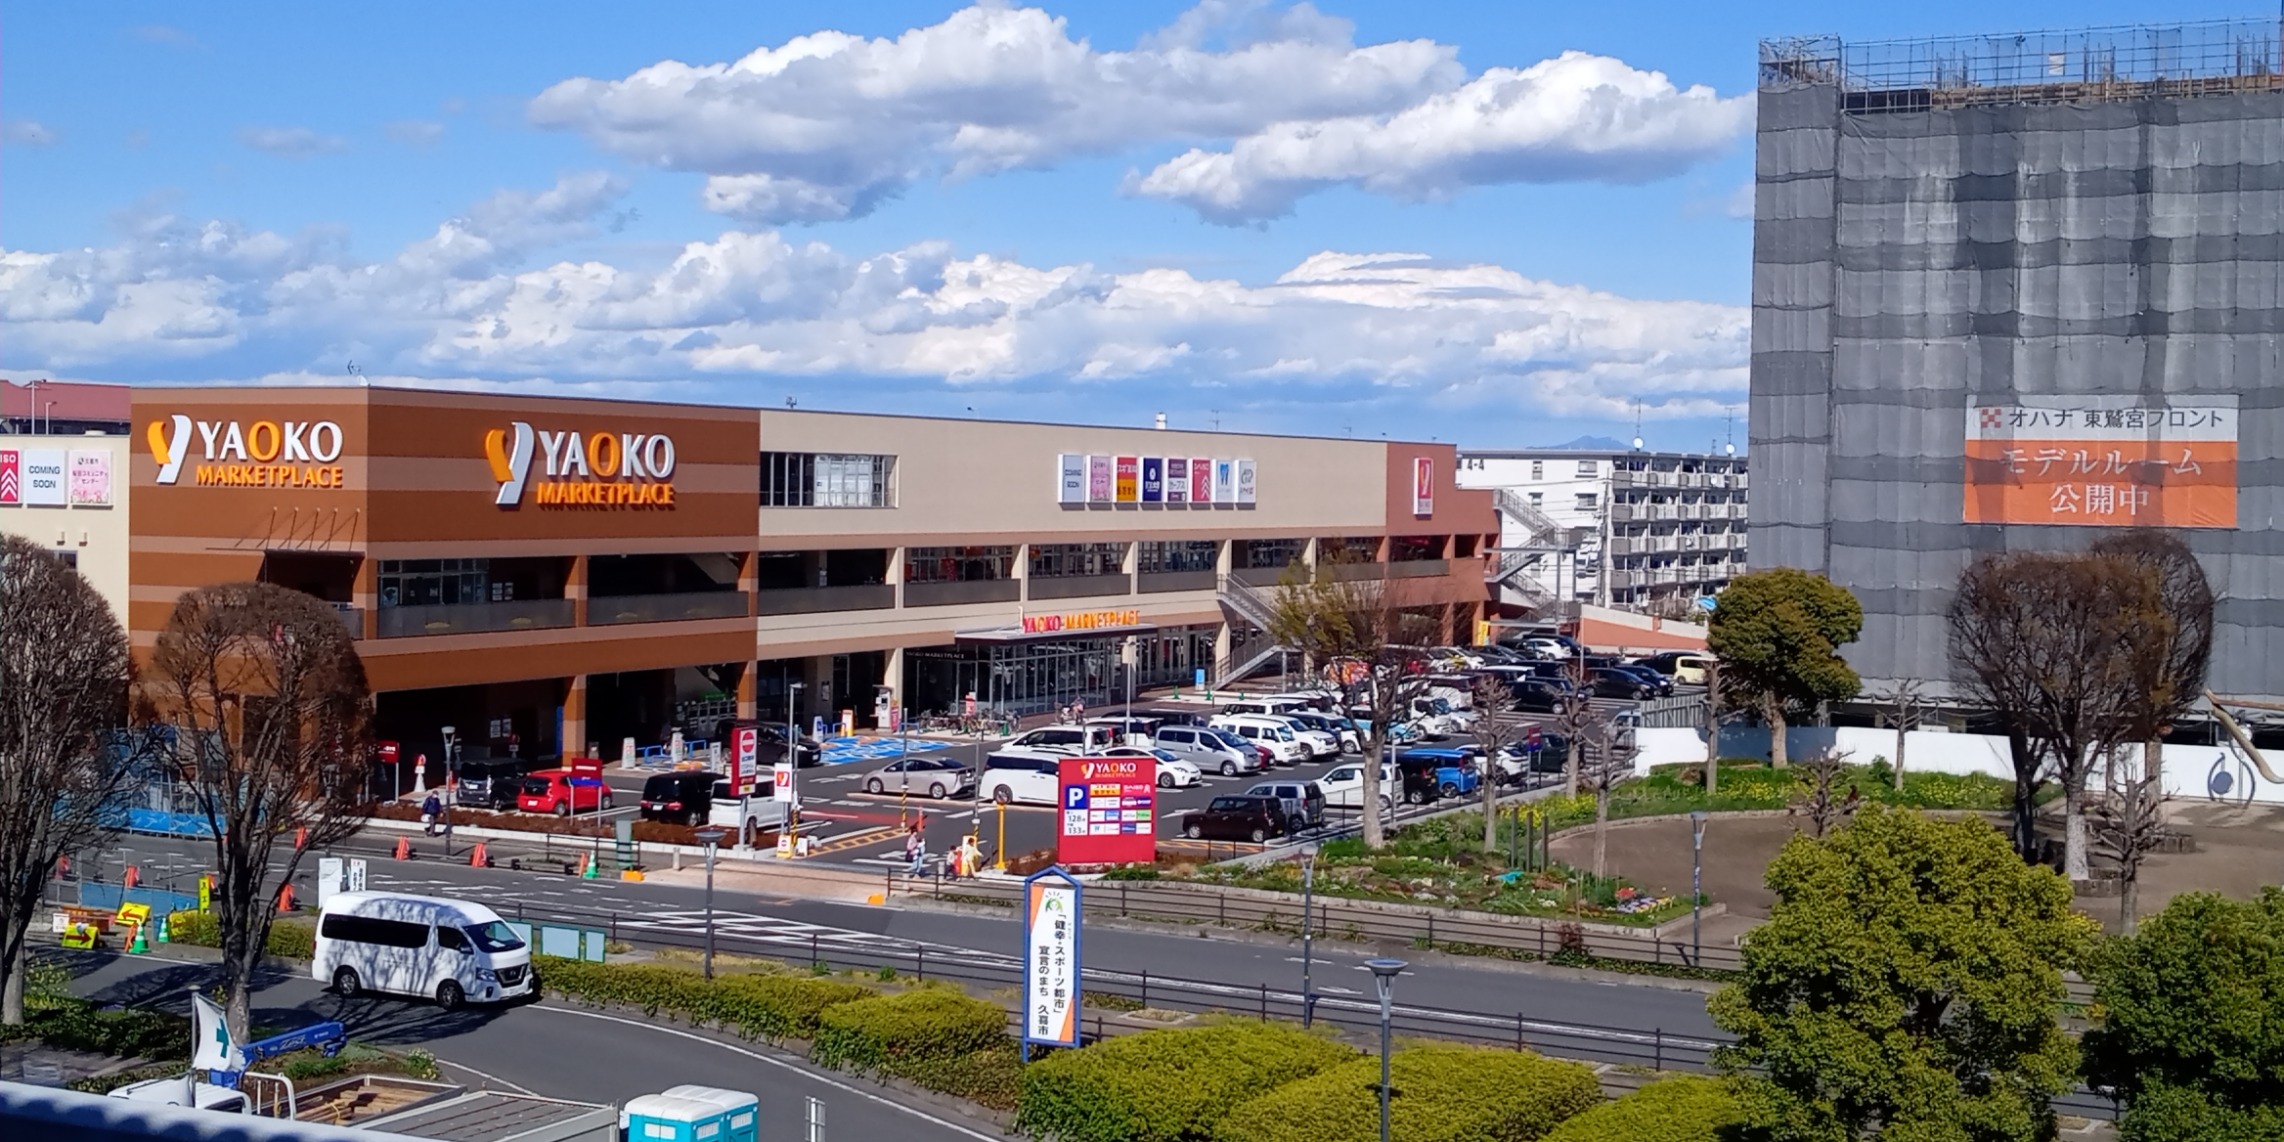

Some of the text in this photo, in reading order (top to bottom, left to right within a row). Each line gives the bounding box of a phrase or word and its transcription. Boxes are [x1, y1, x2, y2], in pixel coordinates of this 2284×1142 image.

[2009, 409, 2224, 429] オハナ 東鷲宮フロント
[196, 420, 344, 462] YAOKO
[538, 430, 675, 478] YAOKO
[2002, 448, 2203, 477] モデルルーム
[28, 465, 61, 475] COMING
[196, 465, 344, 487] MARKETPLACE
[33, 480, 56, 488] SOON
[537, 482, 674, 505] MARKETPLACE
[2049, 483, 2150, 515] 公開中
[1023, 610, 1140, 634] YAOKO MARKETPLACE
[1096, 762, 1137, 773] YAOKO
[1069, 787, 1084, 807] P
[1037, 945, 1050, 1035] 宣言のまち 久喜市
